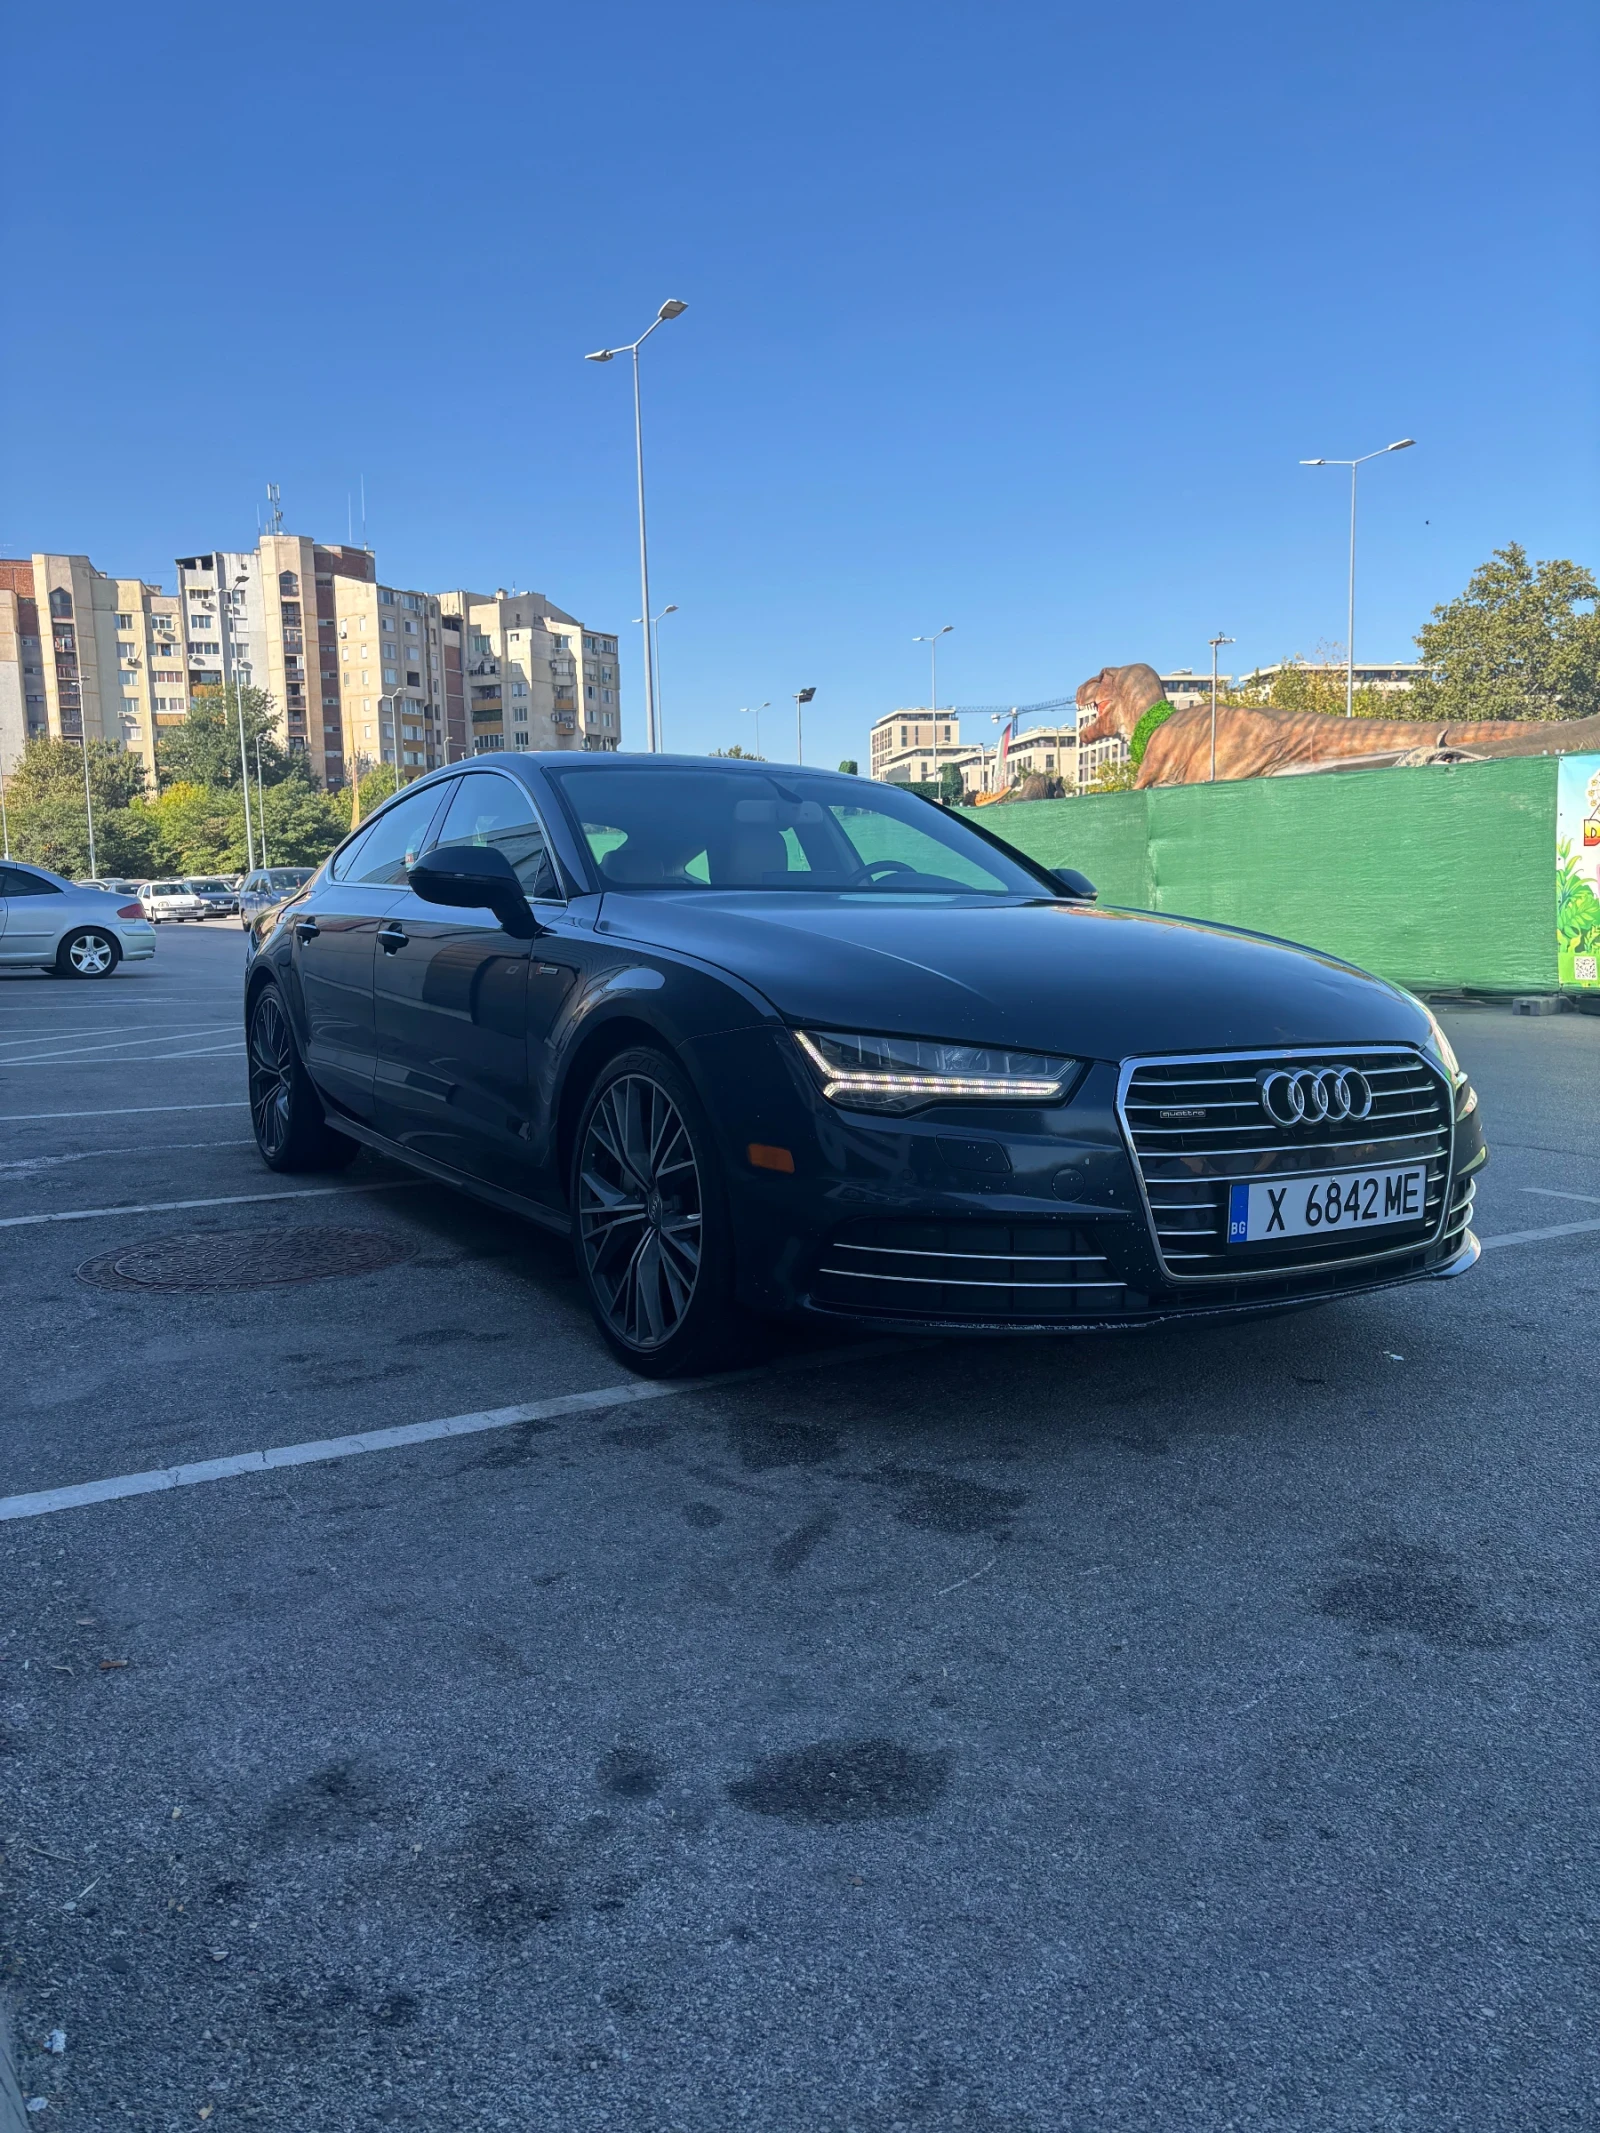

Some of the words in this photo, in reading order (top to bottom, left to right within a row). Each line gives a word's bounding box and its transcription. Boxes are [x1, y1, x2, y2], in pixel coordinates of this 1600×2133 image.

[1162, 1110, 1205, 1118] quattro
[1265, 1187, 1287, 1233] X
[1305, 1178, 1379, 1227] 6842
[1384, 1172, 1421, 1218] ME
[1231, 1220, 1246, 1235] BG
